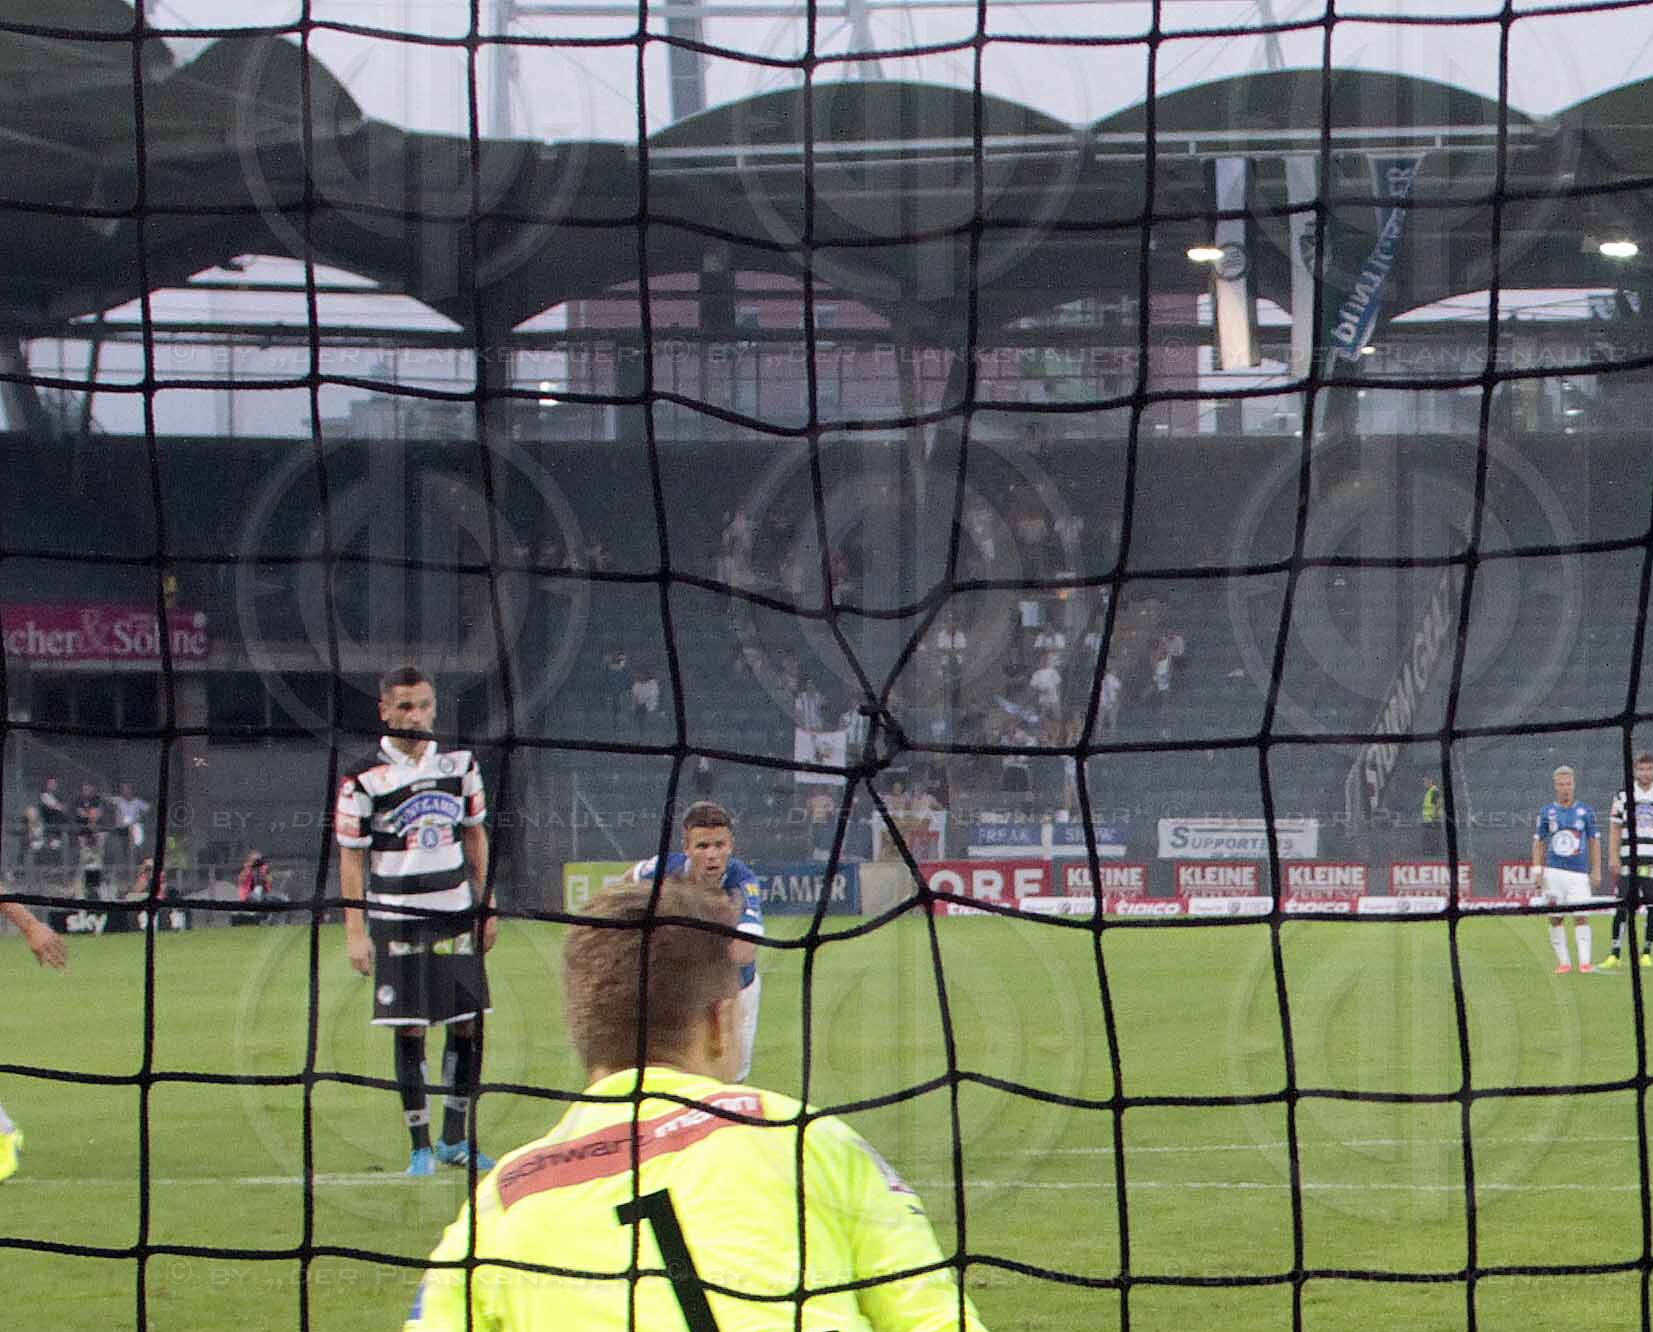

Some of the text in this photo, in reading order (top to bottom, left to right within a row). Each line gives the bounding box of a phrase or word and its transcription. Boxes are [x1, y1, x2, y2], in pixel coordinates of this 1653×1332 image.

[1170, 826, 1294, 849] SUPPORTES
[1179, 867, 1255, 886] KLEINE
[1288, 867, 1366, 886] KLEINE
[66, 910, 108, 934] sky
